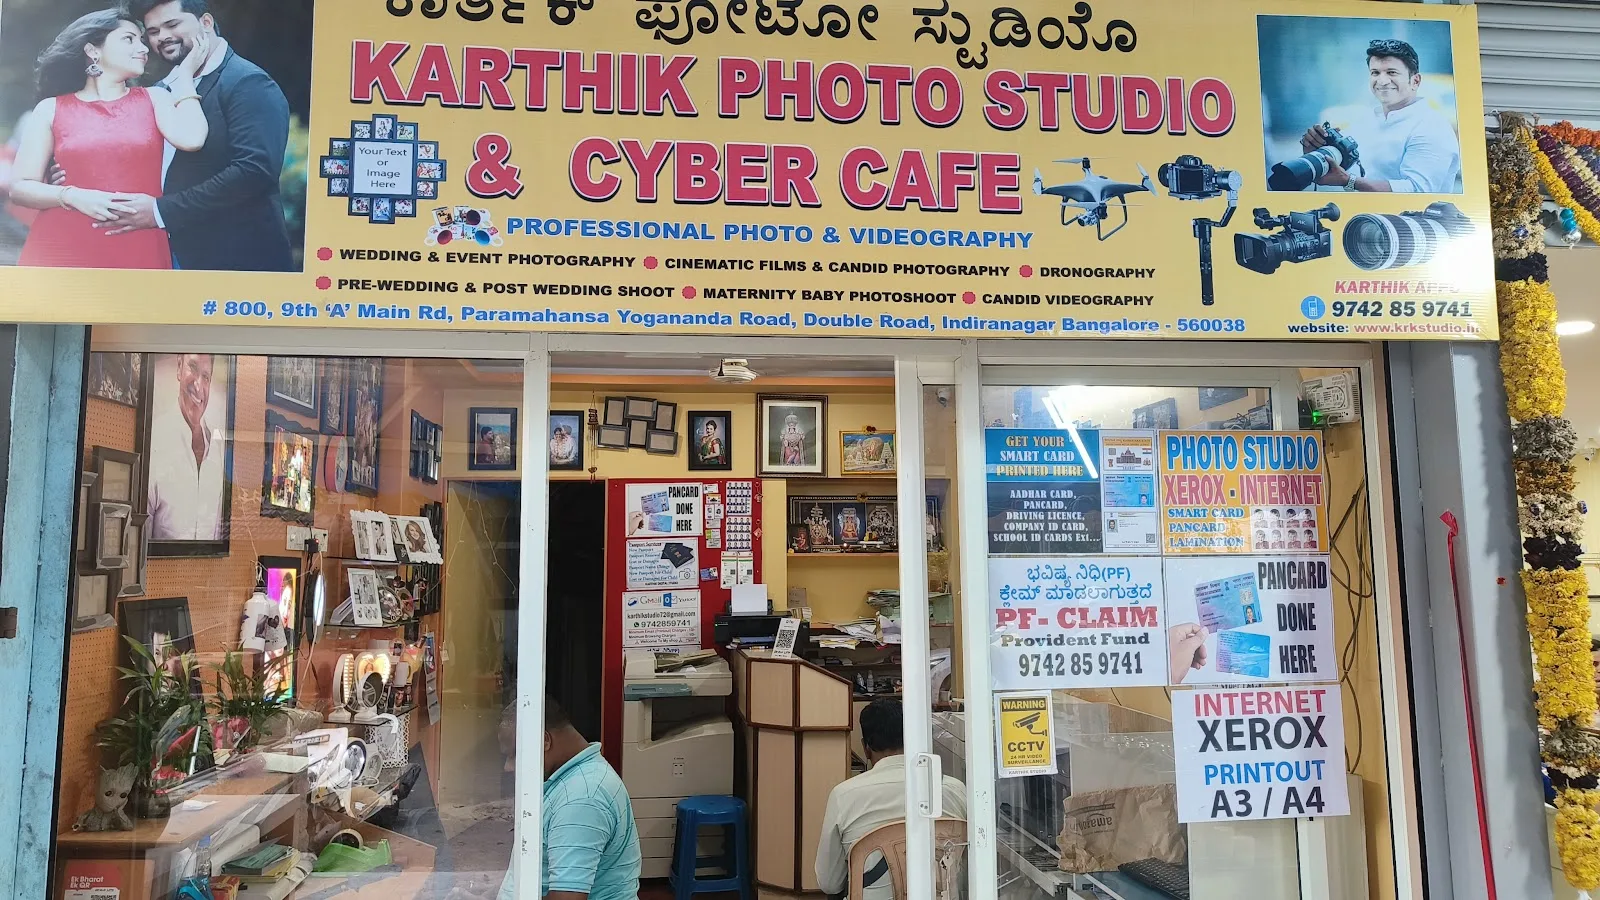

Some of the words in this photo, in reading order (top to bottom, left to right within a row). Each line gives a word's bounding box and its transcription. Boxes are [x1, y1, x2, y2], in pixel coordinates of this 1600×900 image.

[350, 39, 698, 117] KARTHIK
[718, 56, 964, 128] PHOTO
[983, 69, 1236, 137] STUDIO
[359, 147, 383, 157] Your
[385, 148, 408, 157] Text
[366, 169, 401, 179] Image
[465, 133, 524, 199] &
[569, 137, 822, 208] CYBER
[839, 146, 1023, 213] CAFE
[370, 180, 396, 189] Here
[507, 217, 715, 240] PROFESSIONAL
[724, 222, 813, 242] PHOTO
[822, 226, 841, 243] &
[850, 226, 1034, 249] VIDEOGRAPHY
[340, 249, 422, 263] WEDDING
[427, 251, 440, 263] &
[446, 252, 502, 265] EVENT
[508, 254, 636, 268] PHOTOGRAPHY
[664, 258, 755, 271] CINEMATIC
[759, 260, 807, 272] FILMS
[812, 261, 823, 273] &
[828, 262, 889, 274] CANDID
[893, 264, 1010, 277] PHOTOGRAPHY
[1040, 266, 1156, 279] DRONOGRAPHY
[338, 279, 458, 293] PRE-WEDDING
[465, 280, 477, 293] &
[483, 281, 529, 295] POST
[533, 283, 613, 296] WEDDING
[618, 284, 675, 298] SHOOT
[1334, 280, 1410, 294] KARTHIK
[703, 287, 796, 300] MATERNITY
[801, 290, 844, 302] BABY
[849, 291, 957, 304] PHOTOSHOOT
[982, 293, 1041, 305] CANDID
[1045, 293, 1154, 306] VIDEOGRAPHY
[1332, 300, 1383, 317] 9742
[1389, 300, 1416, 317] 85
[1422, 301, 1472, 317] 9741
[203, 301, 217, 315] #
[224, 301, 274, 319] 800,
[281, 302, 318, 318] 9th
[358, 304, 410, 319] Main
[419, 305, 453, 323] Rd,
[461, 306, 610, 324] Paramahansa
[617, 308, 735, 328] Yogananda
[740, 311, 797, 329] Road,
[804, 312, 873, 328] Double
[879, 313, 935, 331] Road,
[941, 315, 1056, 333] Indiranagar
[1062, 317, 1160, 335] Bangalore
[1177, 318, 1246, 333] 560038
[1288, 323, 1349, 334] website:
[1005, 436, 1029, 447] GET
[1032, 436, 1065, 447] YOUR
[1000, 450, 1040, 462] SMART
[1043, 450, 1075, 462] CARD
[1166, 435, 1239, 471] PHOTO
[1243, 435, 1319, 471] STUDIO
[995, 465, 1049, 477] PRINTED
[1053, 465, 1084, 477] HERE
[668, 486, 699, 498] PANCARD
[1010, 490, 1047, 499] AADHAR
[1050, 490, 1077, 500] CARD,
[1163, 474, 1227, 507] XEROX
[1239, 473, 1323, 506] INTERNET
[676, 502, 694, 515] DONE
[1023, 501, 1068, 511] PANCARD,
[1006, 511, 1045, 521] DRIVING
[1047, 512, 1085, 521] LICENCE,
[1168, 508, 1209, 518] SMART
[1211, 508, 1244, 518] CARD
[676, 519, 693, 532] HERE
[1003, 523, 1046, 531] COMPANY
[1048, 523, 1059, 531] ID
[1061, 523, 1089, 532] CARD,
[1168, 522, 1227, 533] PANCARD
[993, 533, 1029, 542] SCHOOL
[1030, 533, 1041, 542] ID
[1044, 533, 1073, 542] CARDS
[1169, 537, 1245, 548] LAMINATION
[1257, 561, 1328, 590] PANCARD
[641, 619, 691, 628] 9742859741
[995, 608, 1049, 630] PF-
[1057, 606, 1158, 629] CLAIM
[1277, 602, 1317, 632] DONE
[1001, 633, 1097, 647] Provident
[1101, 632, 1150, 646] Fund
[1018, 653, 1066, 677] 9742
[1070, 653, 1093, 676] 85
[1098, 651, 1143, 675] 9741
[1279, 645, 1318, 674] HERE
[1002, 700, 1046, 710] WARNING
[1195, 689, 1326, 717] INTERNET
[1197, 715, 1328, 752] XEROX
[1007, 741, 1045, 752] CCTV
[1205, 759, 1325, 785] PRINTOUT
[1210, 789, 1253, 818] A3
[1263, 787, 1273, 817] /
[1282, 786, 1326, 815] A4
[79, 875, 104, 883] Bharat
